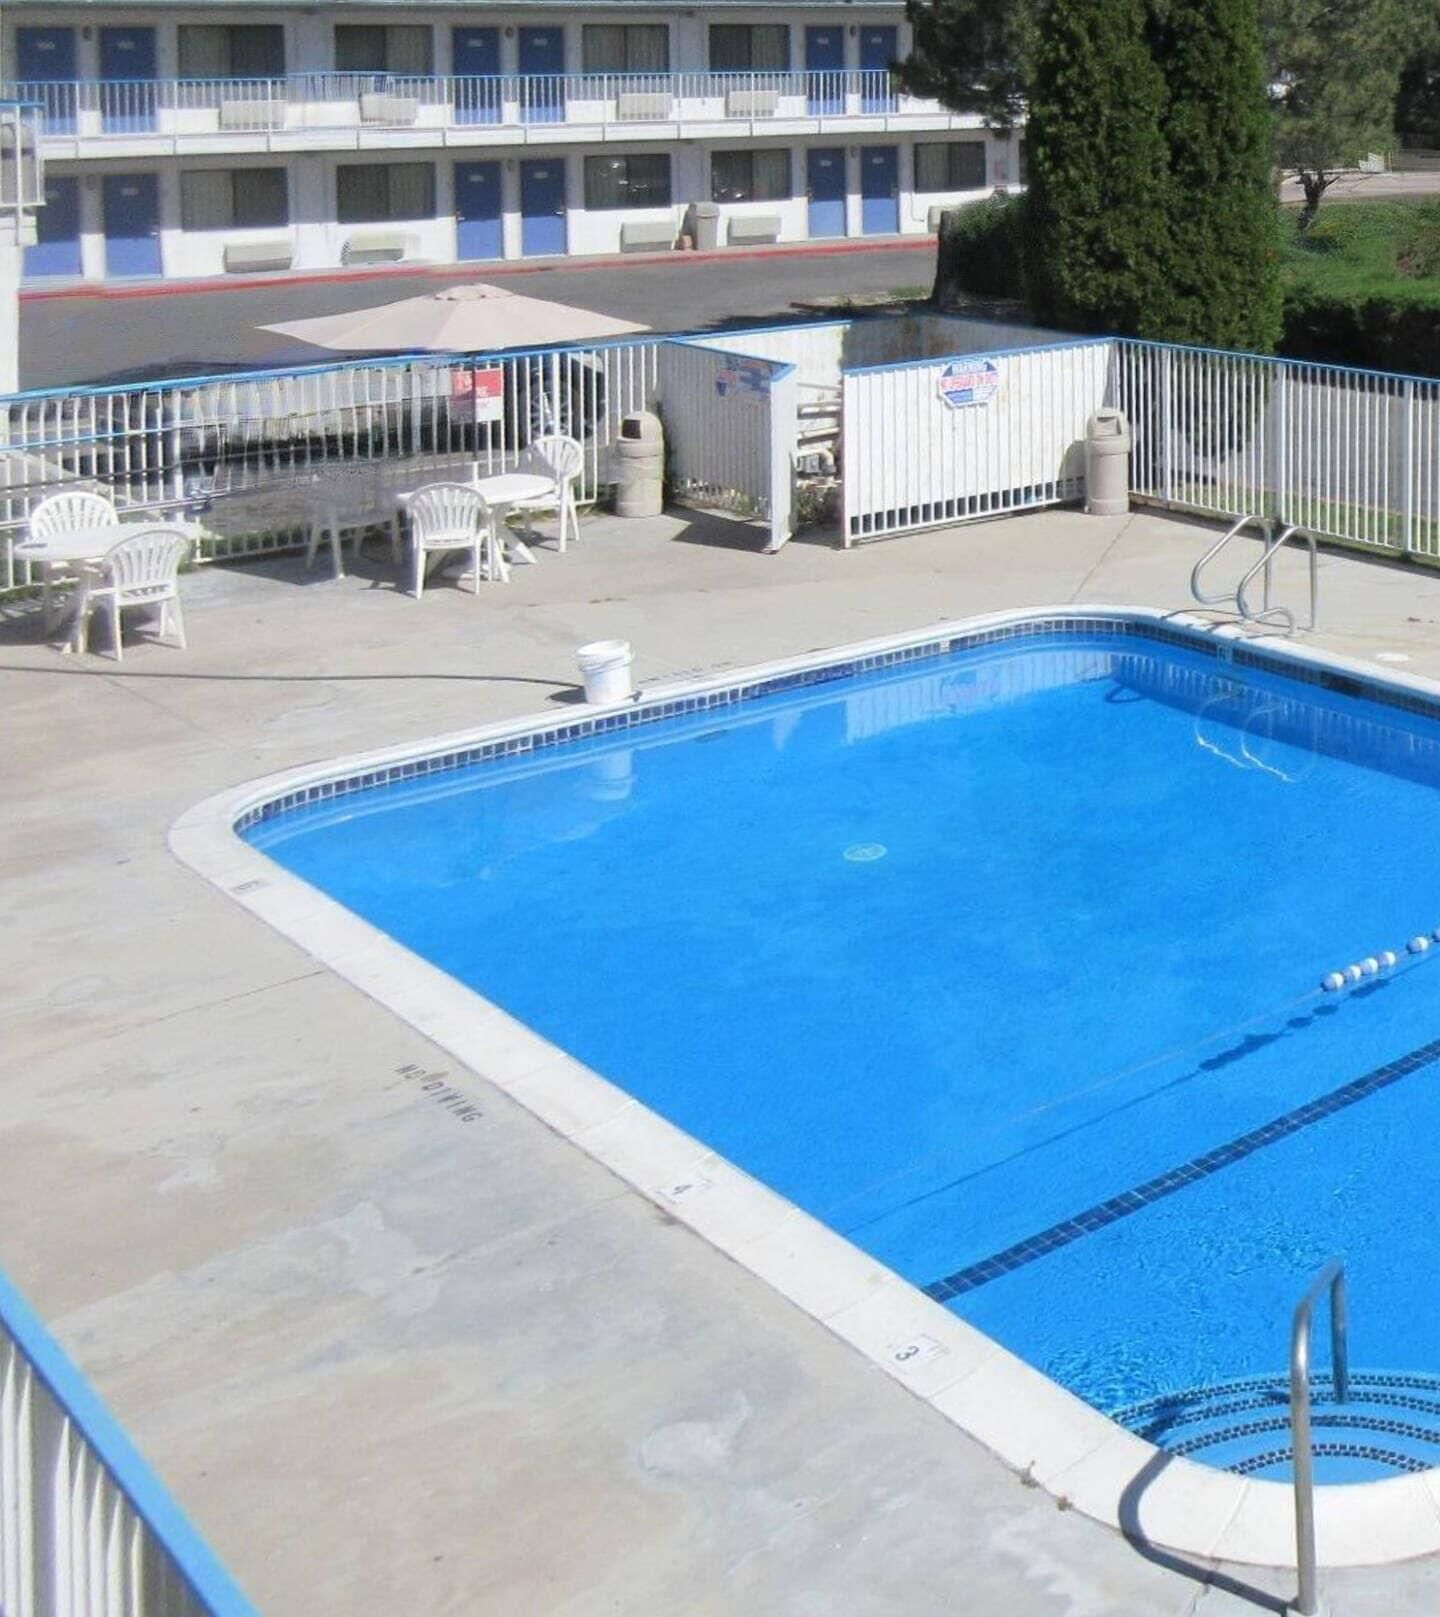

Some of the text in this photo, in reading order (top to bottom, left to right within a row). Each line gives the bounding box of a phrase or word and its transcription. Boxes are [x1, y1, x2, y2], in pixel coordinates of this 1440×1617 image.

[394, 1063, 483, 1122] NO DIVING
[895, 1345, 920, 1361] 3
